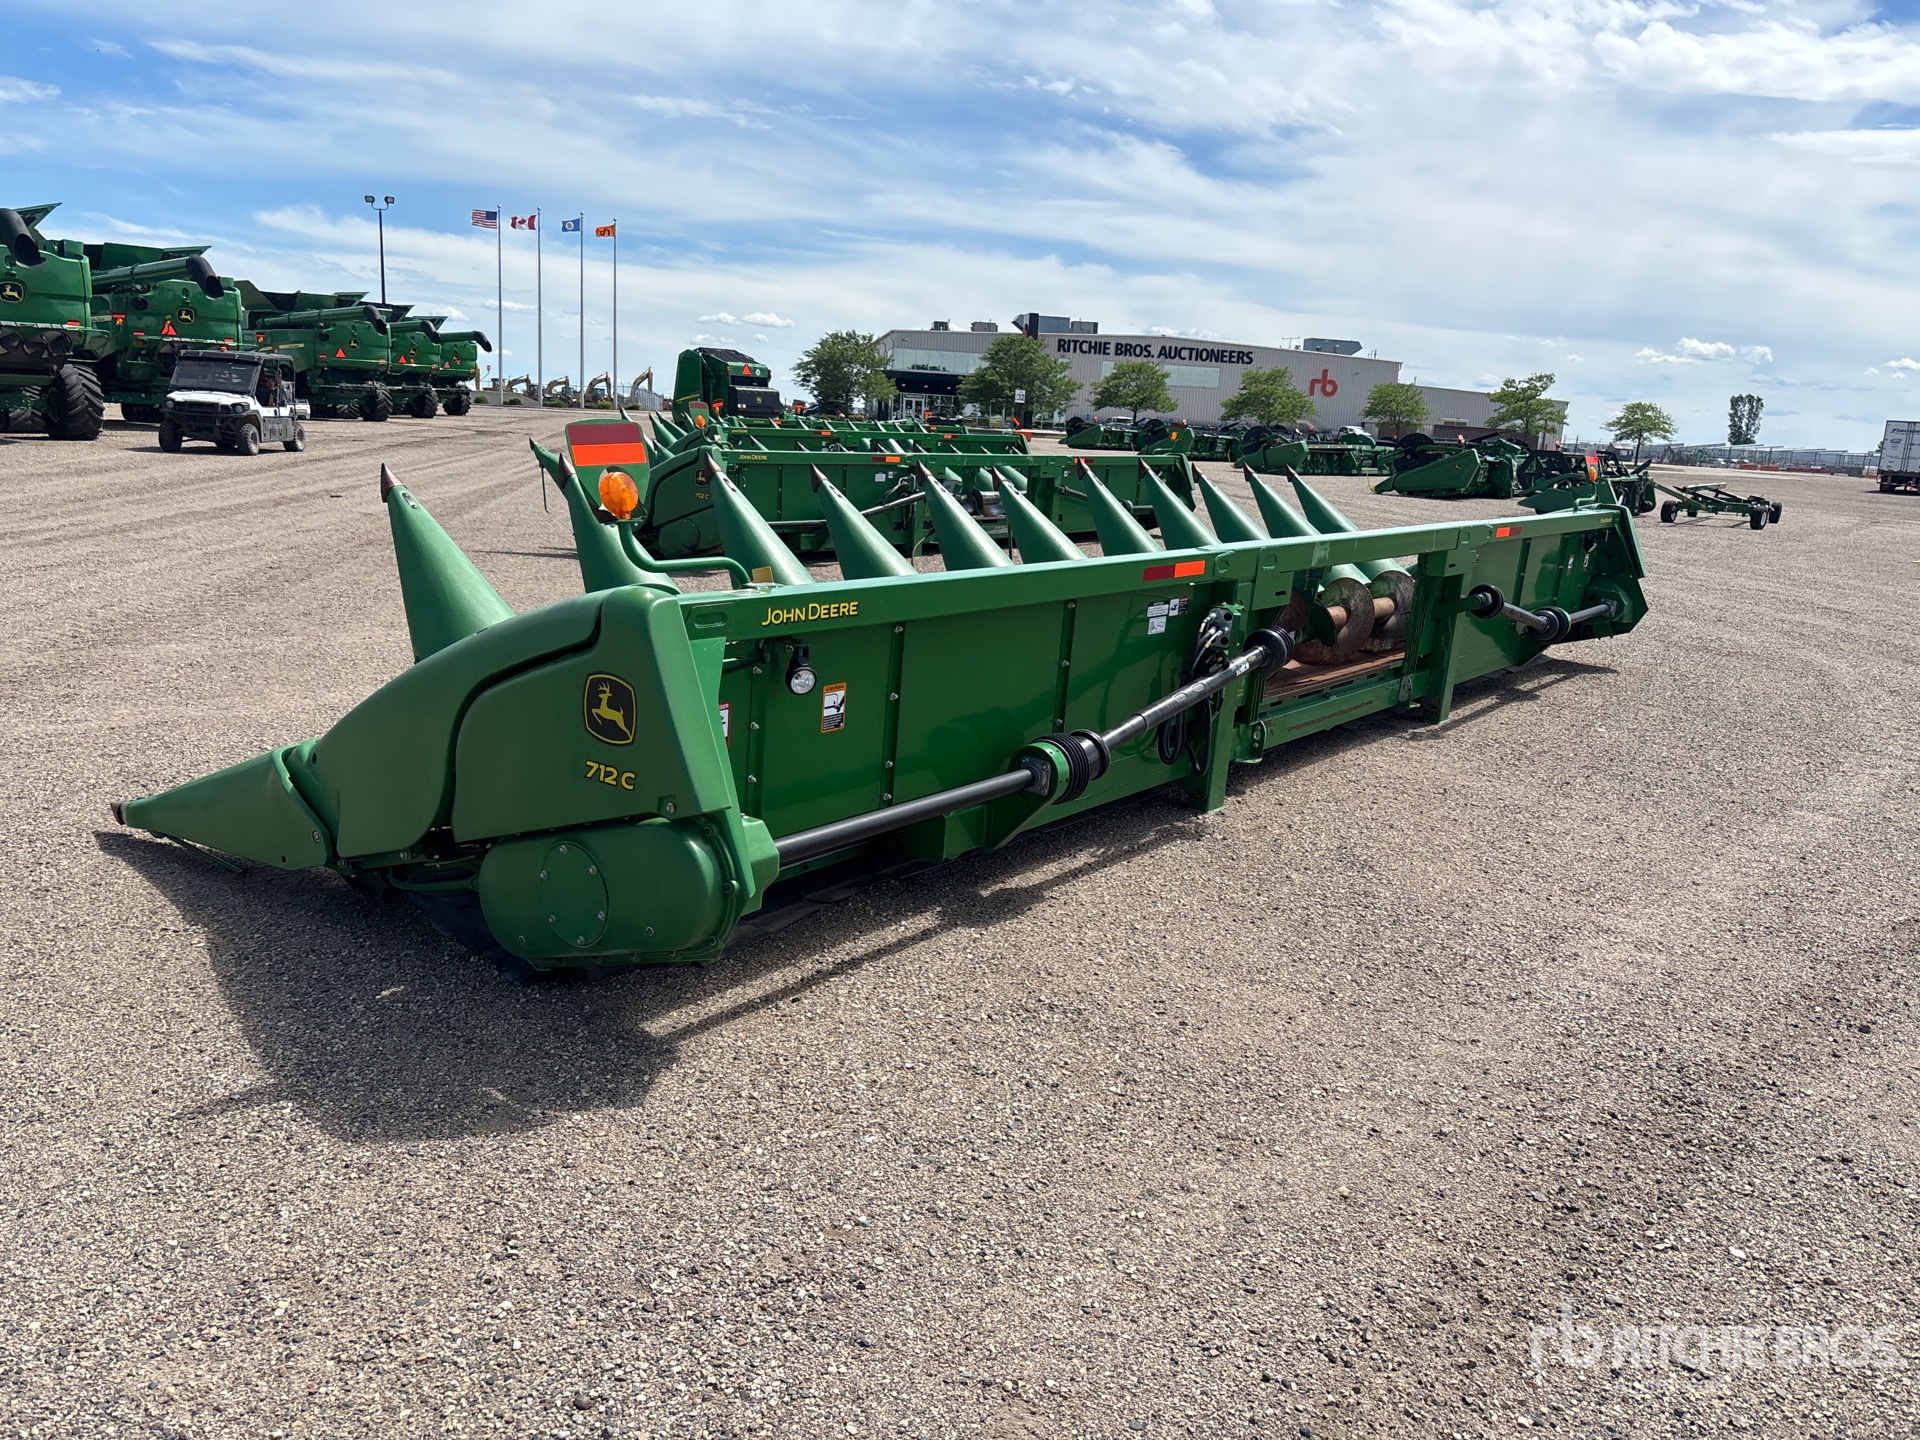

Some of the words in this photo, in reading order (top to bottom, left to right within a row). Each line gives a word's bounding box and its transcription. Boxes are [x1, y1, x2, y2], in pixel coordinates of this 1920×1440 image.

[1057, 338, 1111, 356] RITCHIE
[1114, 342, 1155, 359] BROS.
[1157, 345, 1254, 365] AUCTIONEERS
[1309, 369, 1338, 398] rb
[761, 607, 806, 626] JOHN
[808, 601, 859, 620] DEERE
